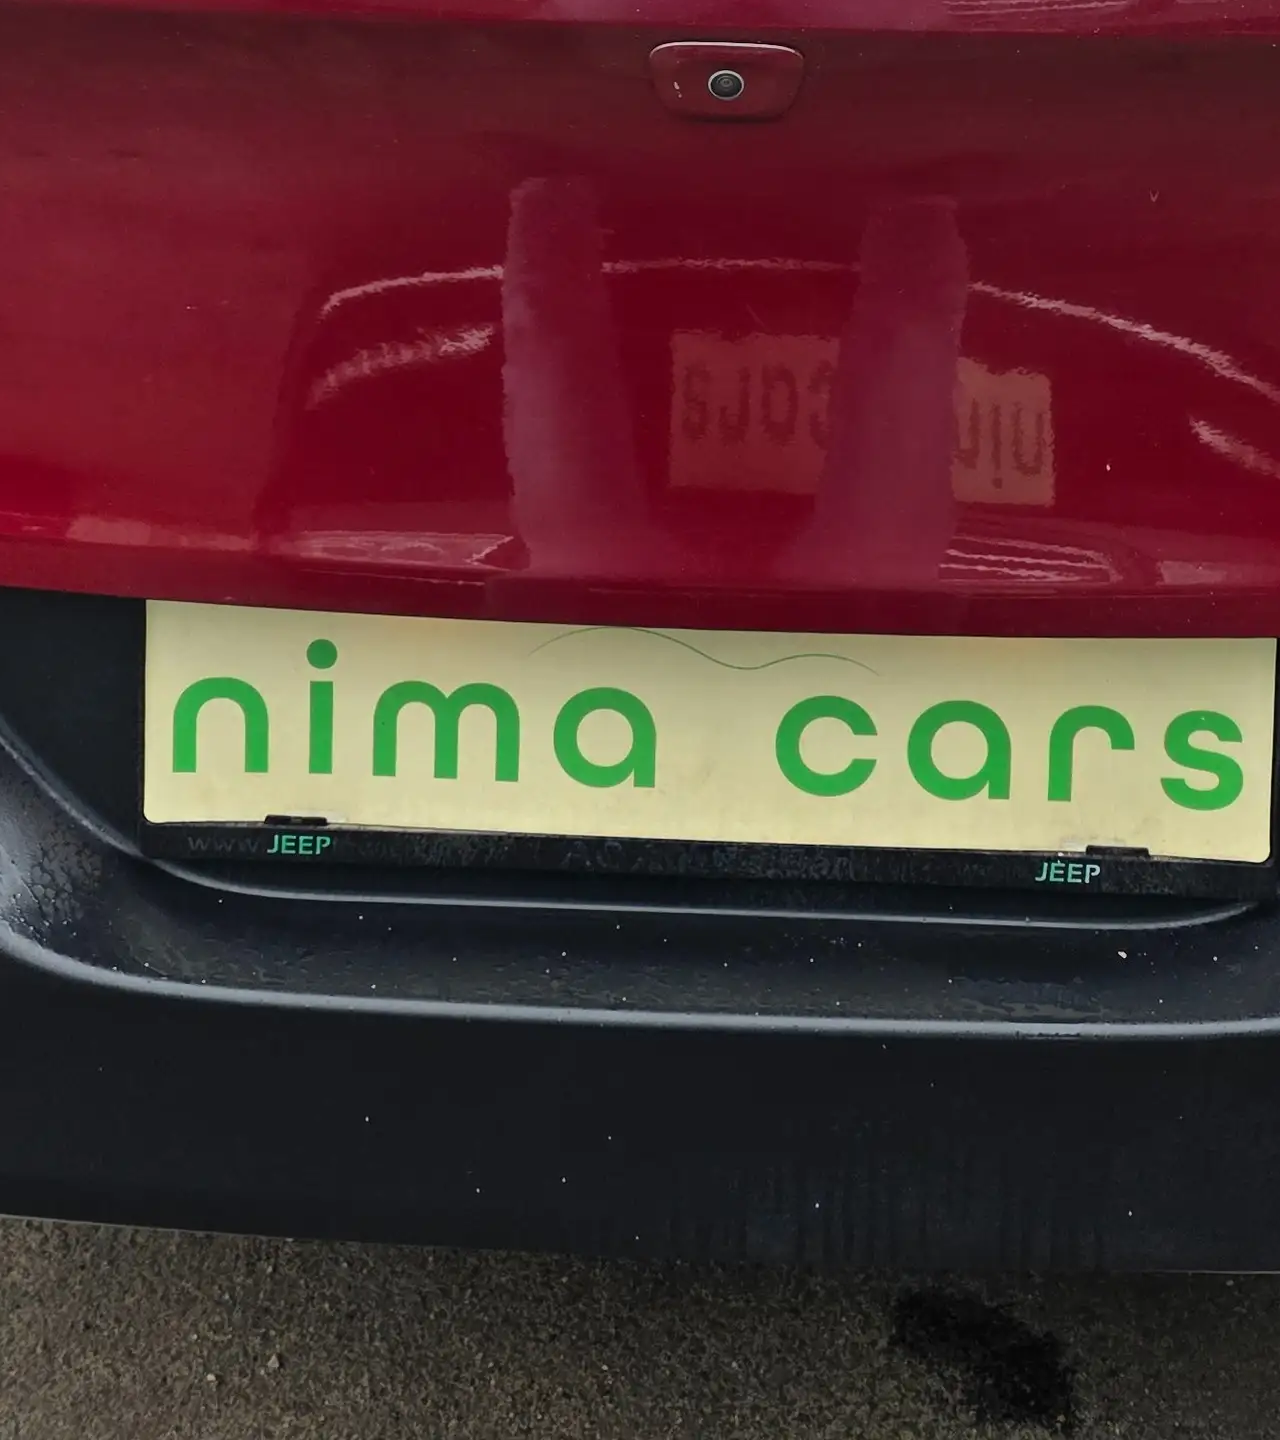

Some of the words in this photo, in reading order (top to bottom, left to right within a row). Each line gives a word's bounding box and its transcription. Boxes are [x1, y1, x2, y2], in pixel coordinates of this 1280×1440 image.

[171, 637, 659, 790] nima
[774, 694, 1245, 812] cars
[266, 833, 332, 856] JEEP
[1034, 861, 1103, 885] JEEP
